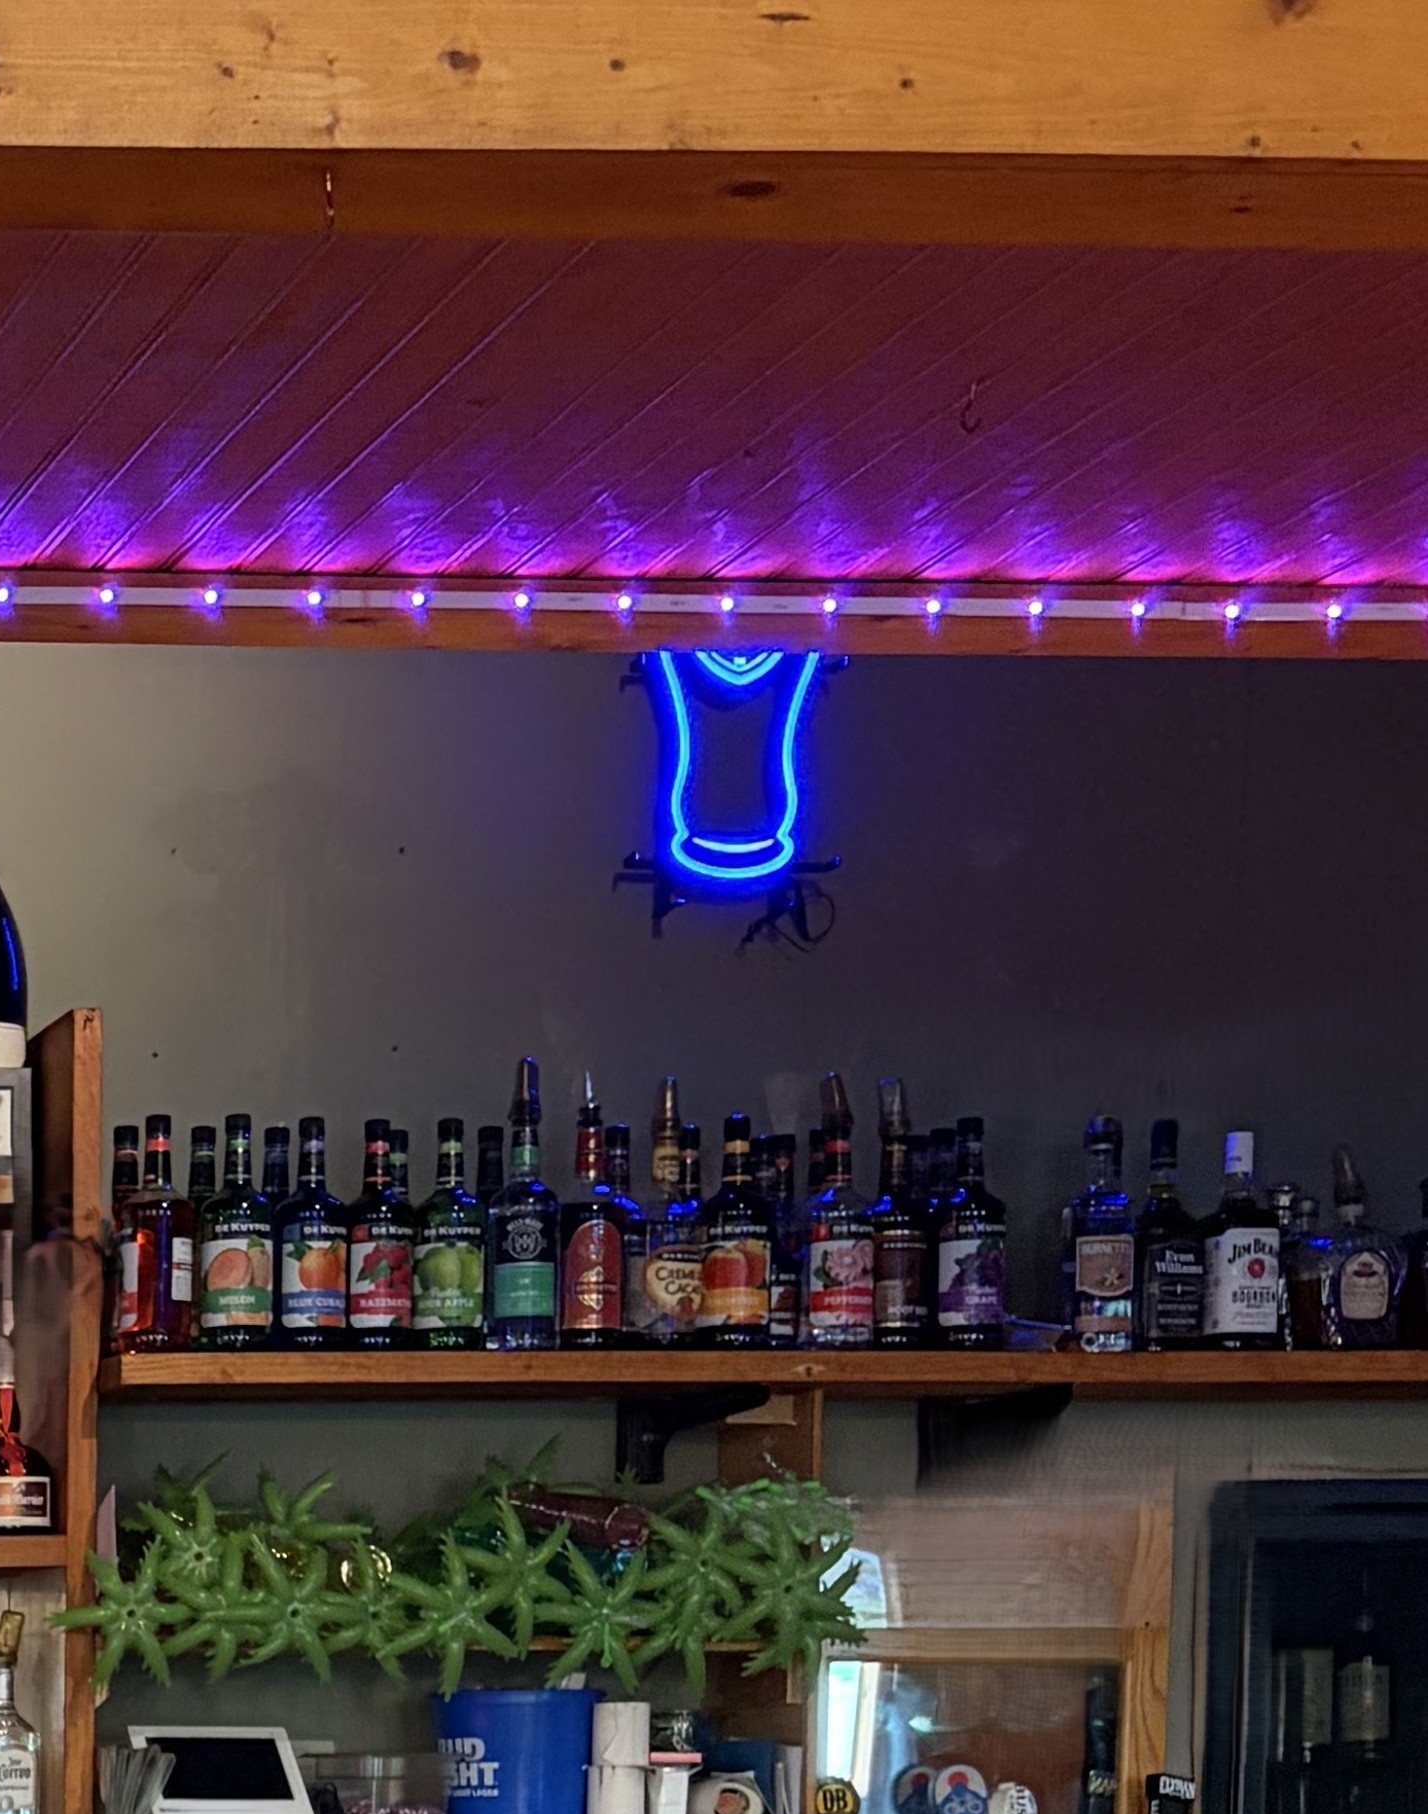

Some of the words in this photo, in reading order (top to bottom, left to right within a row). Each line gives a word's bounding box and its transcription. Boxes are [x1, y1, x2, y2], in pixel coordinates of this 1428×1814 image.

[1164, 1250, 1194, 1263] Evan
[1227, 1243, 1251, 1264] JIM
[1155, 1261, 1204, 1275] Williams
[218, 1295, 256, 1305] MELON
[447, 1762, 499, 1787] GHT
[822, 1789, 848, 1811] DB
